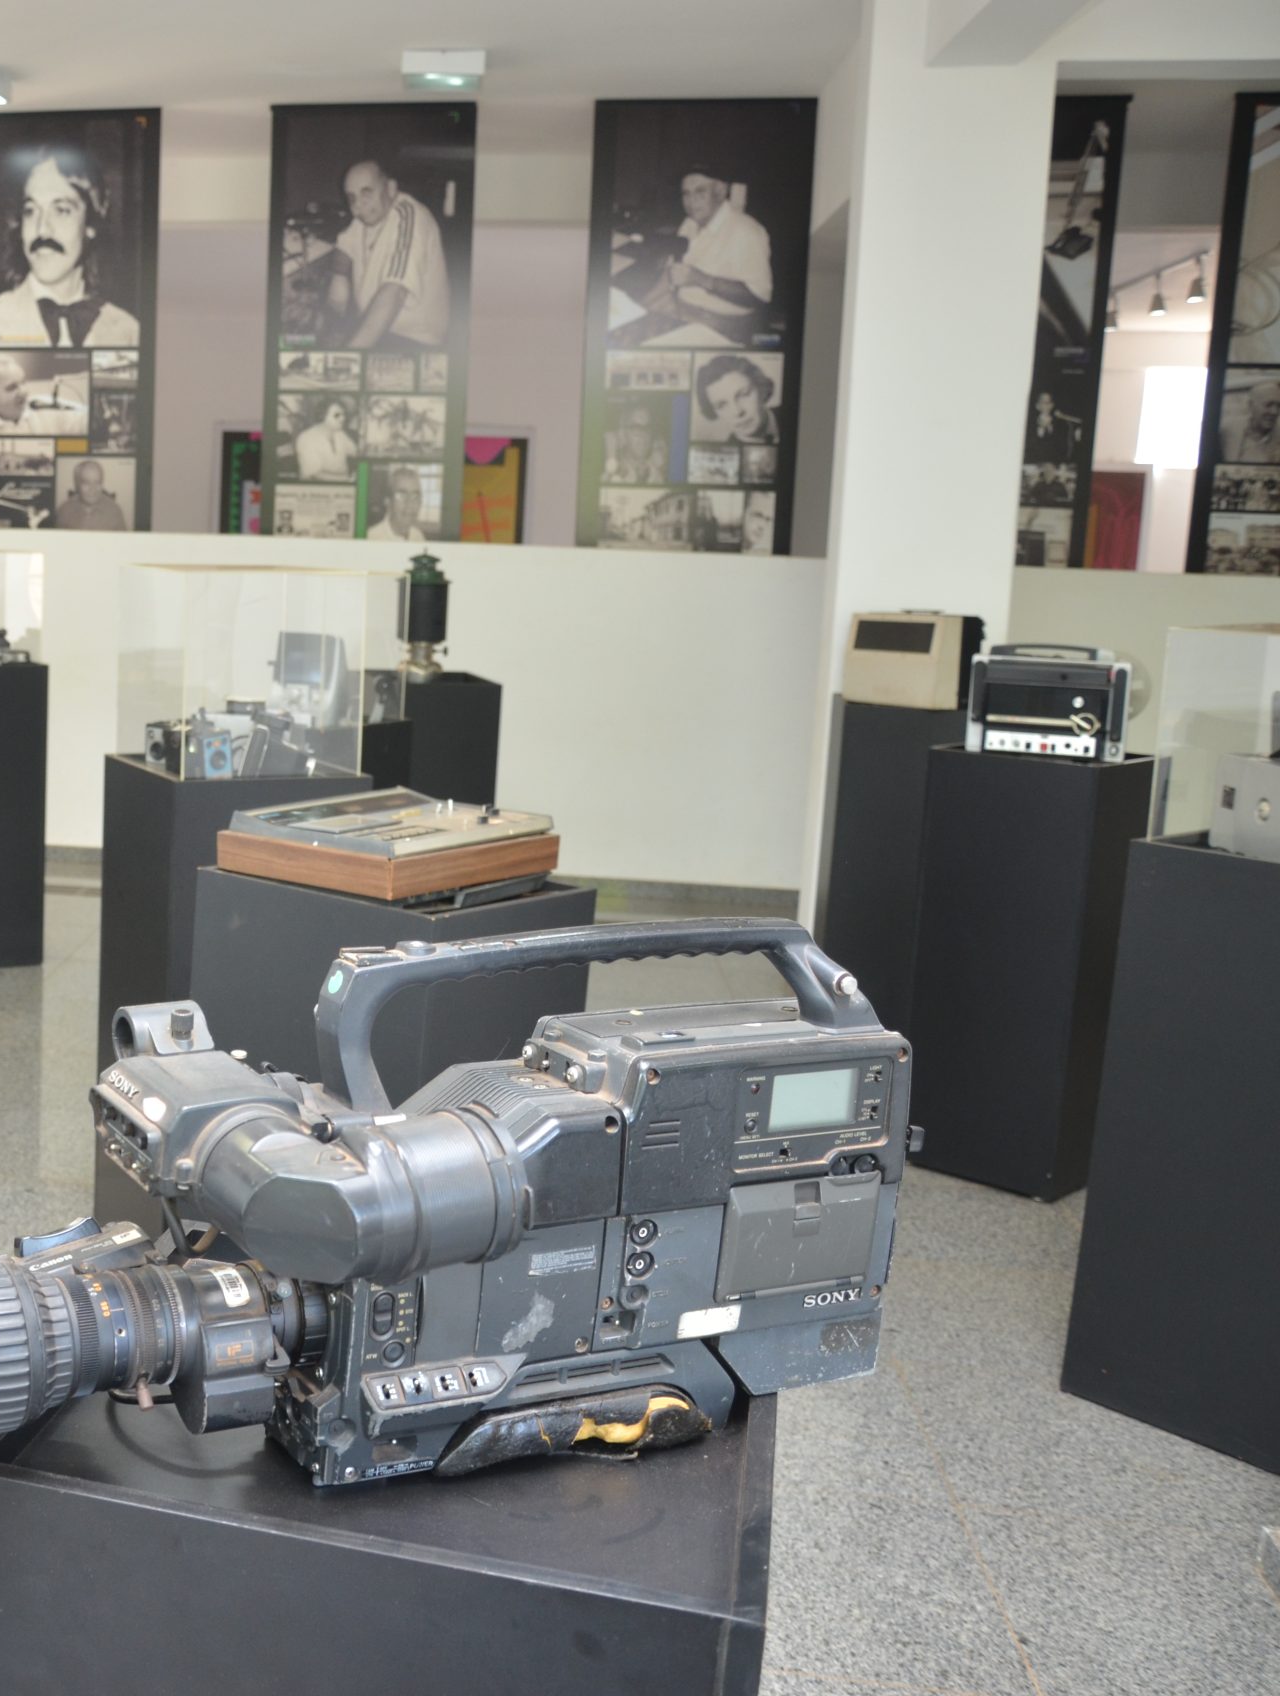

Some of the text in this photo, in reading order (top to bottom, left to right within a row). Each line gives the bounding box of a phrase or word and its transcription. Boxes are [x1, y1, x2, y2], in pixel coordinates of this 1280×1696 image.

[108, 1070, 139, 1099] SONY
[28, 1254, 73, 1272] Canon
[802, 1288, 861, 1309] SONY
